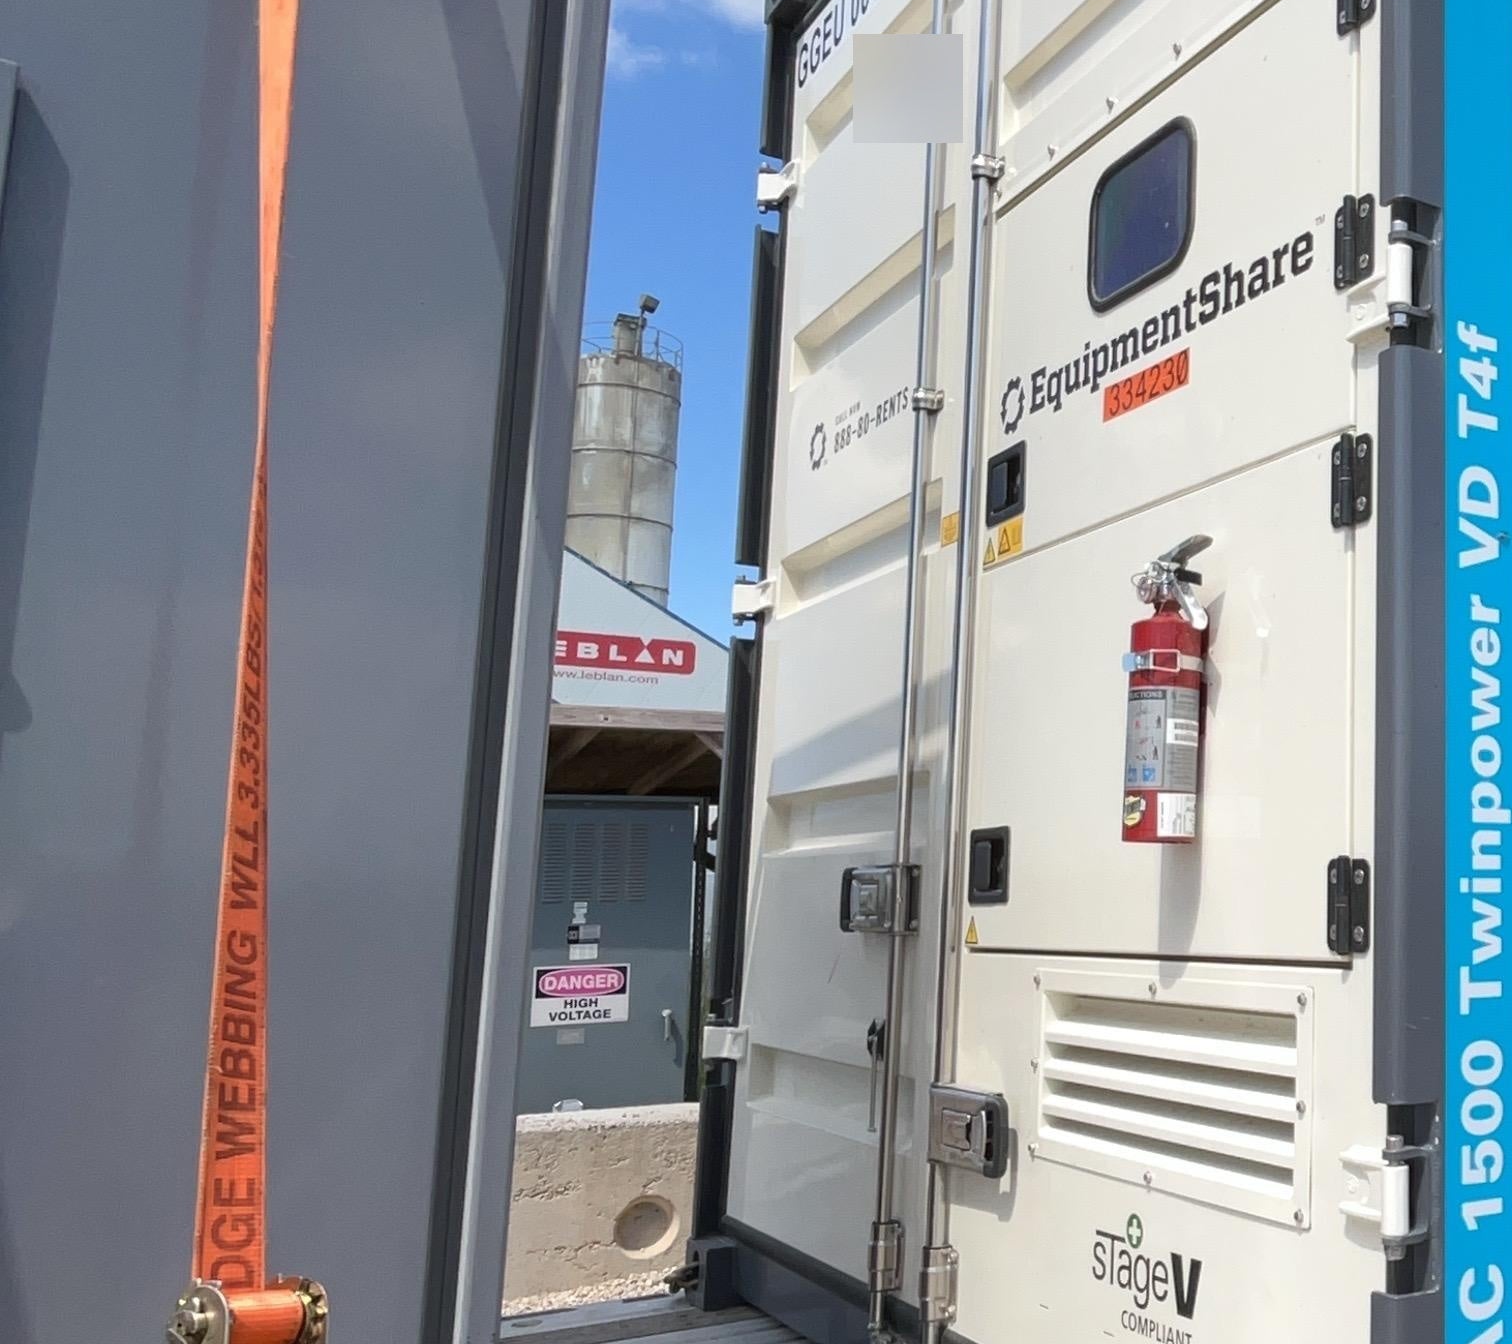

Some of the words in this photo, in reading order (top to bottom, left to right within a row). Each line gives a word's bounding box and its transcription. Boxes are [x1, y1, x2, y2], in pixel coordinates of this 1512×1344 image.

[1028, 230, 1315, 415] EquipmentShare
[1108, 349, 1189, 417] 334230
[1456, 321, 1501, 439] T4f
[833, 386, 909, 454] 888-80-RENTS
[1458, 464, 1501, 569] VD
[553, 670, 659, 685] ww.leblan.com
[555, 640, 684, 667] EBLAN
[1459, 593, 1512, 1016] Twinpower
[230, 821, 261, 911] WLL
[543, 973, 619, 991] DANGER
[548, 1009, 612, 1023] VOLTAGE
[563, 997, 599, 1009] HIGH
[215, 929, 258, 1160] WEBBING
[1459, 1039, 1505, 1232] 1500
